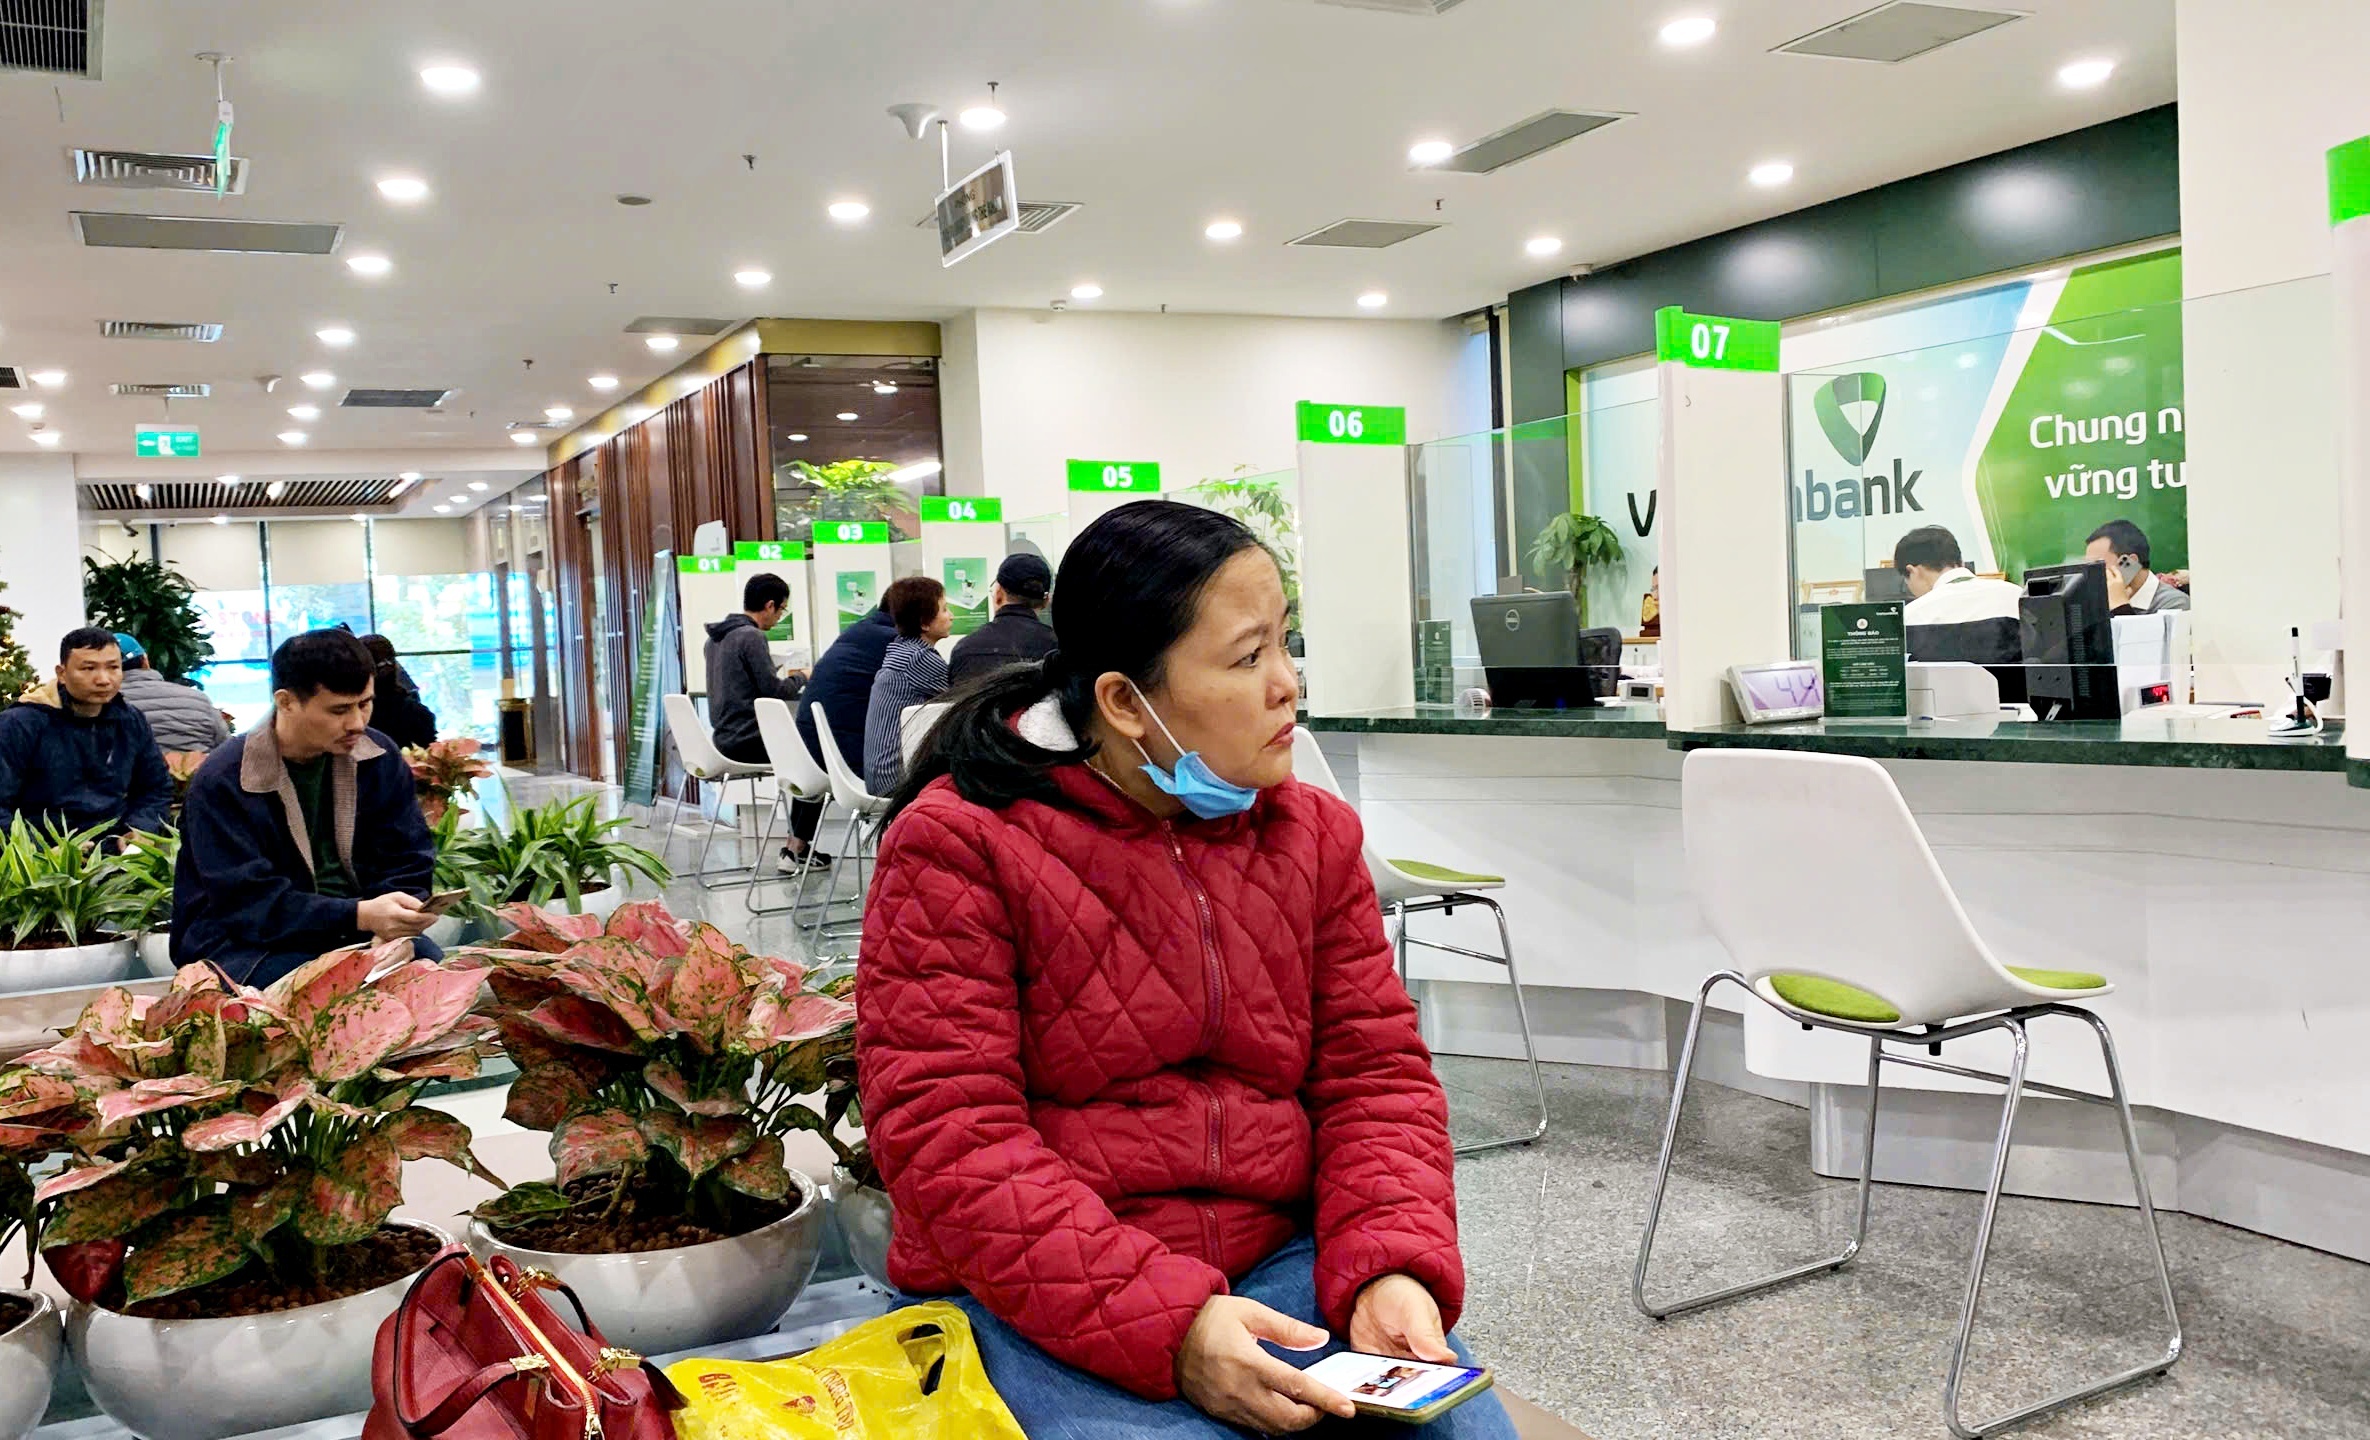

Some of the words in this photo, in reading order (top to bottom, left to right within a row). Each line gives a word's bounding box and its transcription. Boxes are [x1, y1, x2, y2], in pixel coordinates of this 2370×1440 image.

[1691, 323, 1730, 360] 07
[1328, 410, 1363, 438] 06
[2029, 411, 2147, 449] Chung
[1102, 465, 1133, 488] 05
[2044, 463, 2138, 500] vững
[948, 502, 977, 520] 04
[837, 524, 863, 541] 03
[758, 545, 782, 559] 02
[698, 558, 720, 572] 01
